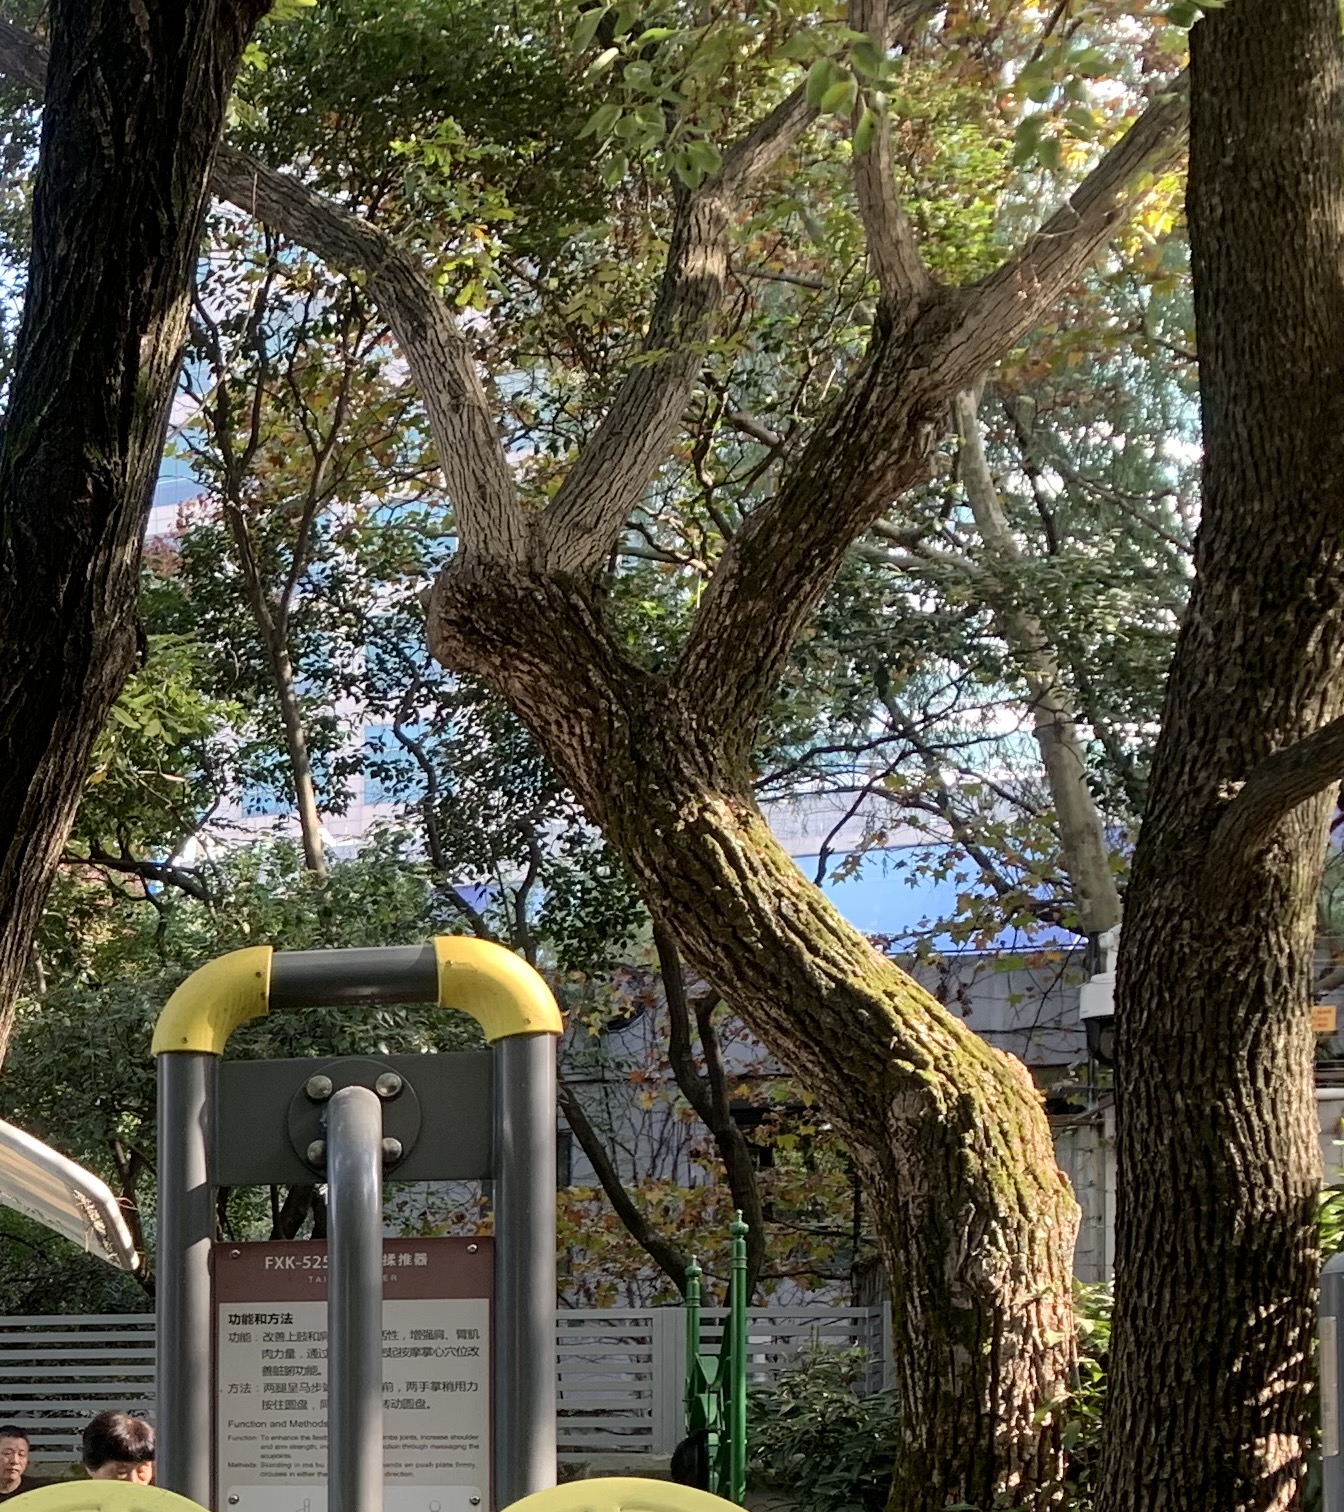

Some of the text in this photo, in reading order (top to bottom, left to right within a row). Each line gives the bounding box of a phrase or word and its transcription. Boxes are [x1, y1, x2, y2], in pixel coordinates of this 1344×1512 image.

[228, 1312, 293, 1325] 功能和方法
[228, 1420, 267, 1428] Function
[269, 1420, 287, 1428] and
